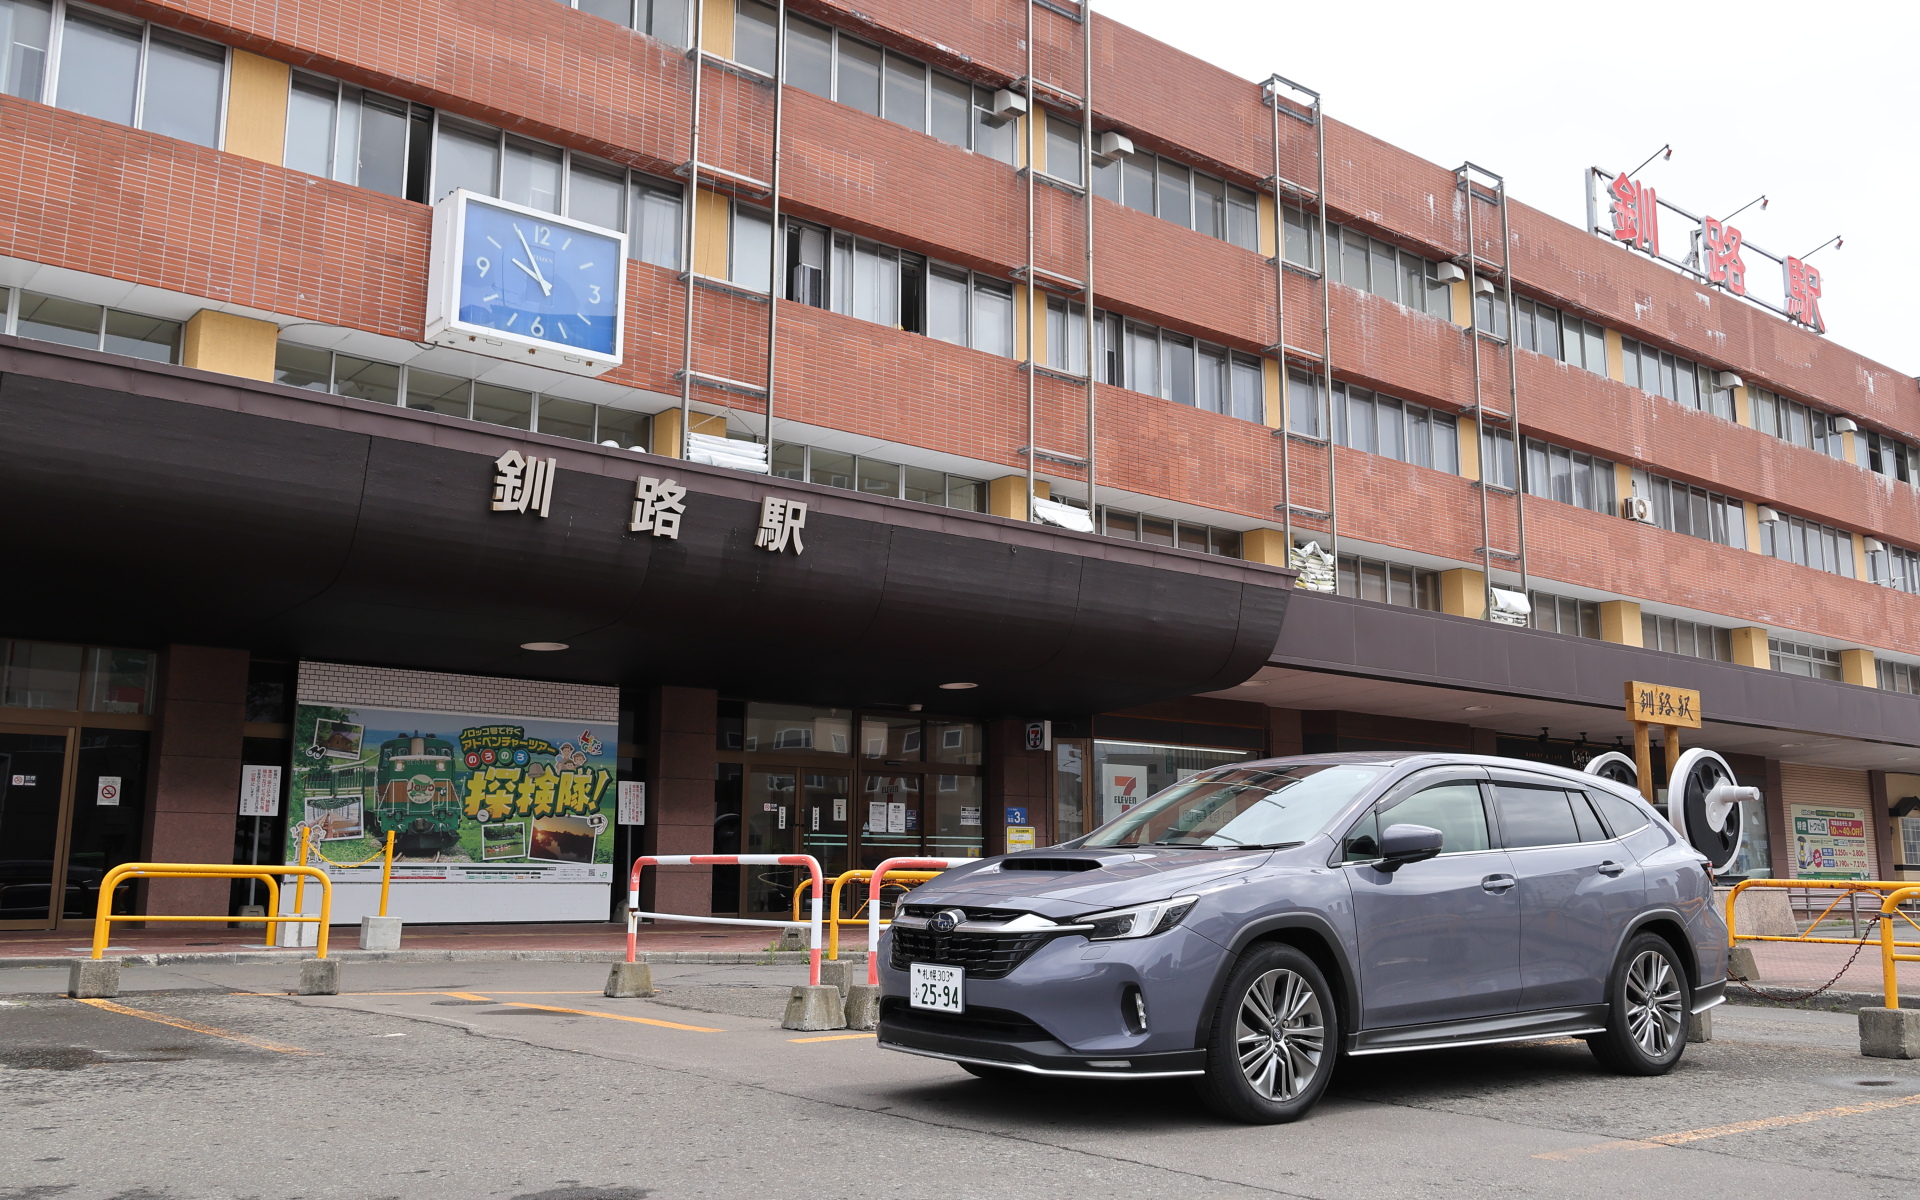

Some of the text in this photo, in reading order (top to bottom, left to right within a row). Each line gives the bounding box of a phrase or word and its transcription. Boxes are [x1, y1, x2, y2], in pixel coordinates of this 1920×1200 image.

[534, 224, 551, 246] 12
[476, 256, 490, 278] 9
[588, 284, 602, 304] 3
[530, 315, 544, 337] 6
[1640, 689, 1694, 721] 釧路駅
[460, 726, 522, 740] ノロッコ号で行く
[461, 736, 557, 753] アドベンチャーツアー
[467, 751, 526, 765] のろのろ
[913, 983, 959, 1009] ふ 25-94
